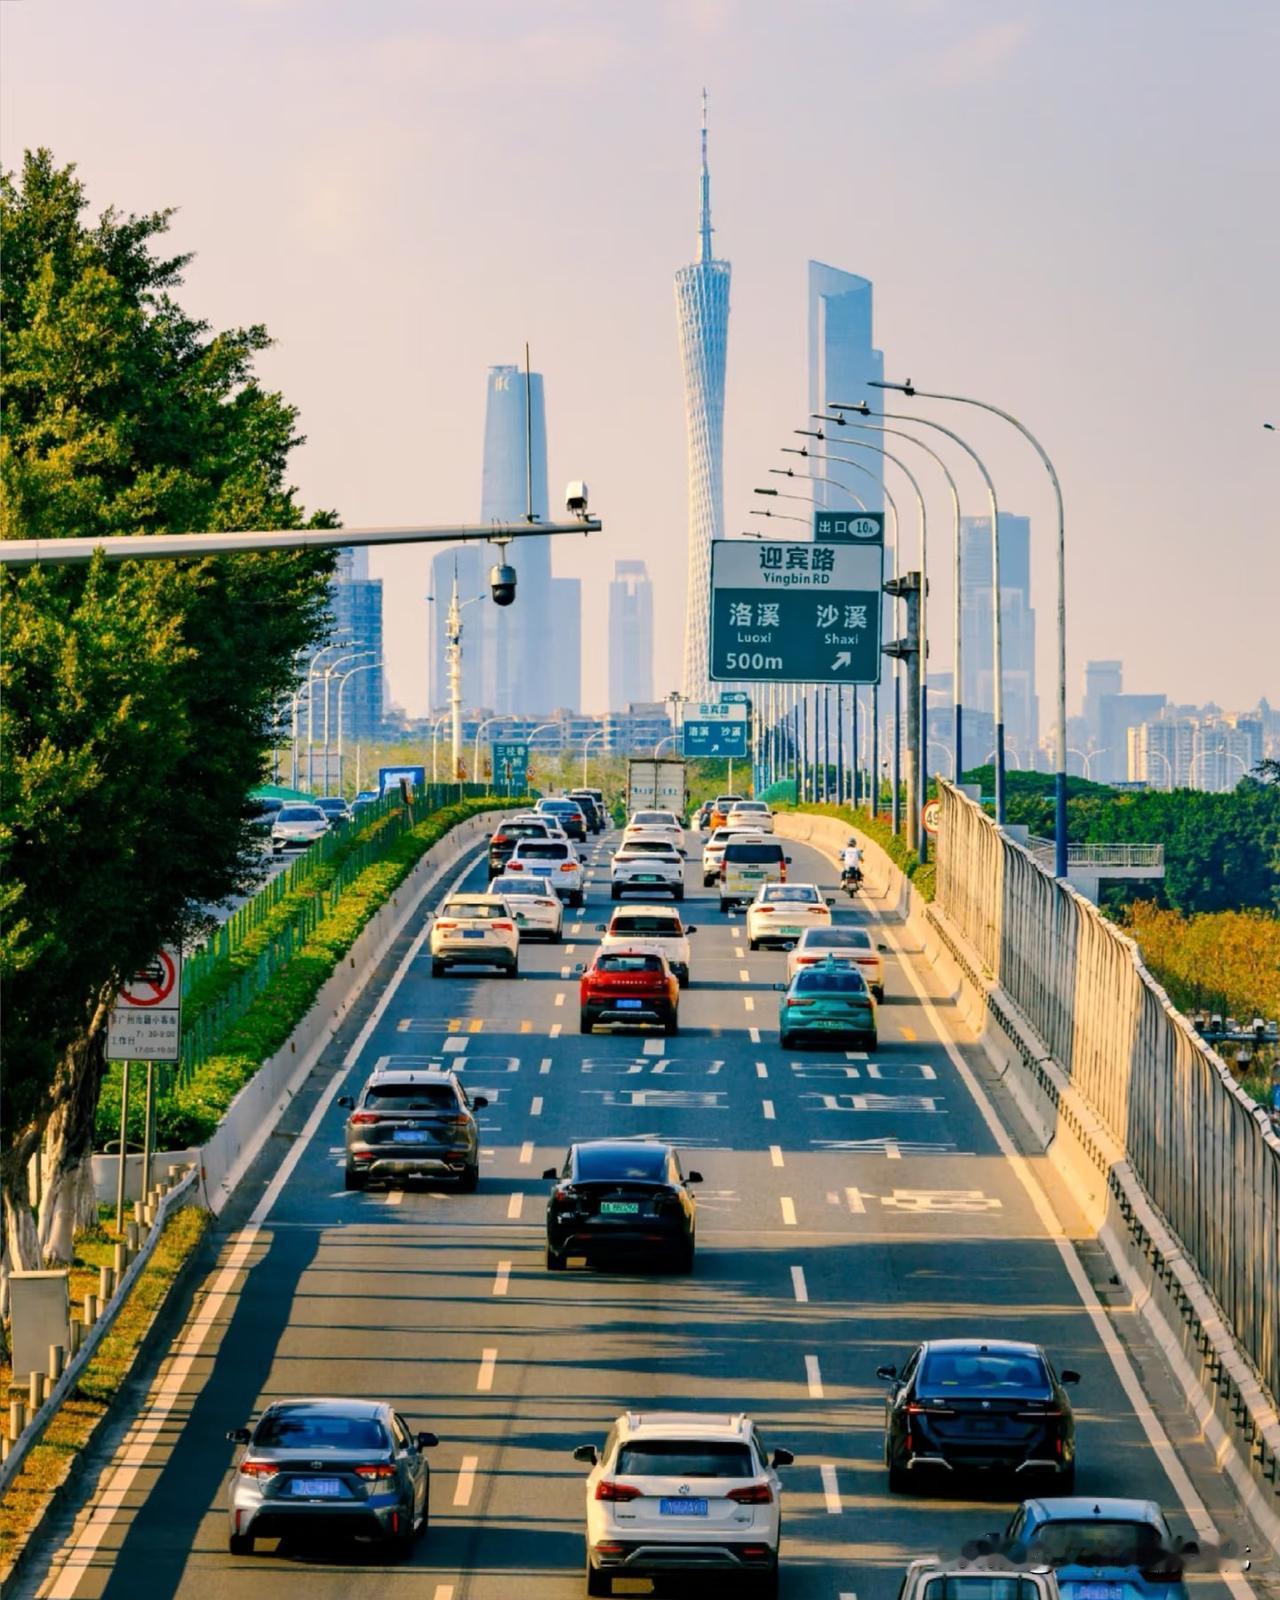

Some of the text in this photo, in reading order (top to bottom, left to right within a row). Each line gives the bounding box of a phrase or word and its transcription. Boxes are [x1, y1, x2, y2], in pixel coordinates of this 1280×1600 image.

[818, 520, 874, 534] 出口 10A
[760, 546, 835, 572] 迎宾路
[763, 572, 830, 587] Yingbin RD
[729, 602, 780, 627] 洛溪
[816, 604, 867, 629] 沙溪
[737, 632, 772, 643] Luoxi
[824, 633, 859, 645] Shaxi
[726, 653, 783, 670] 500m
